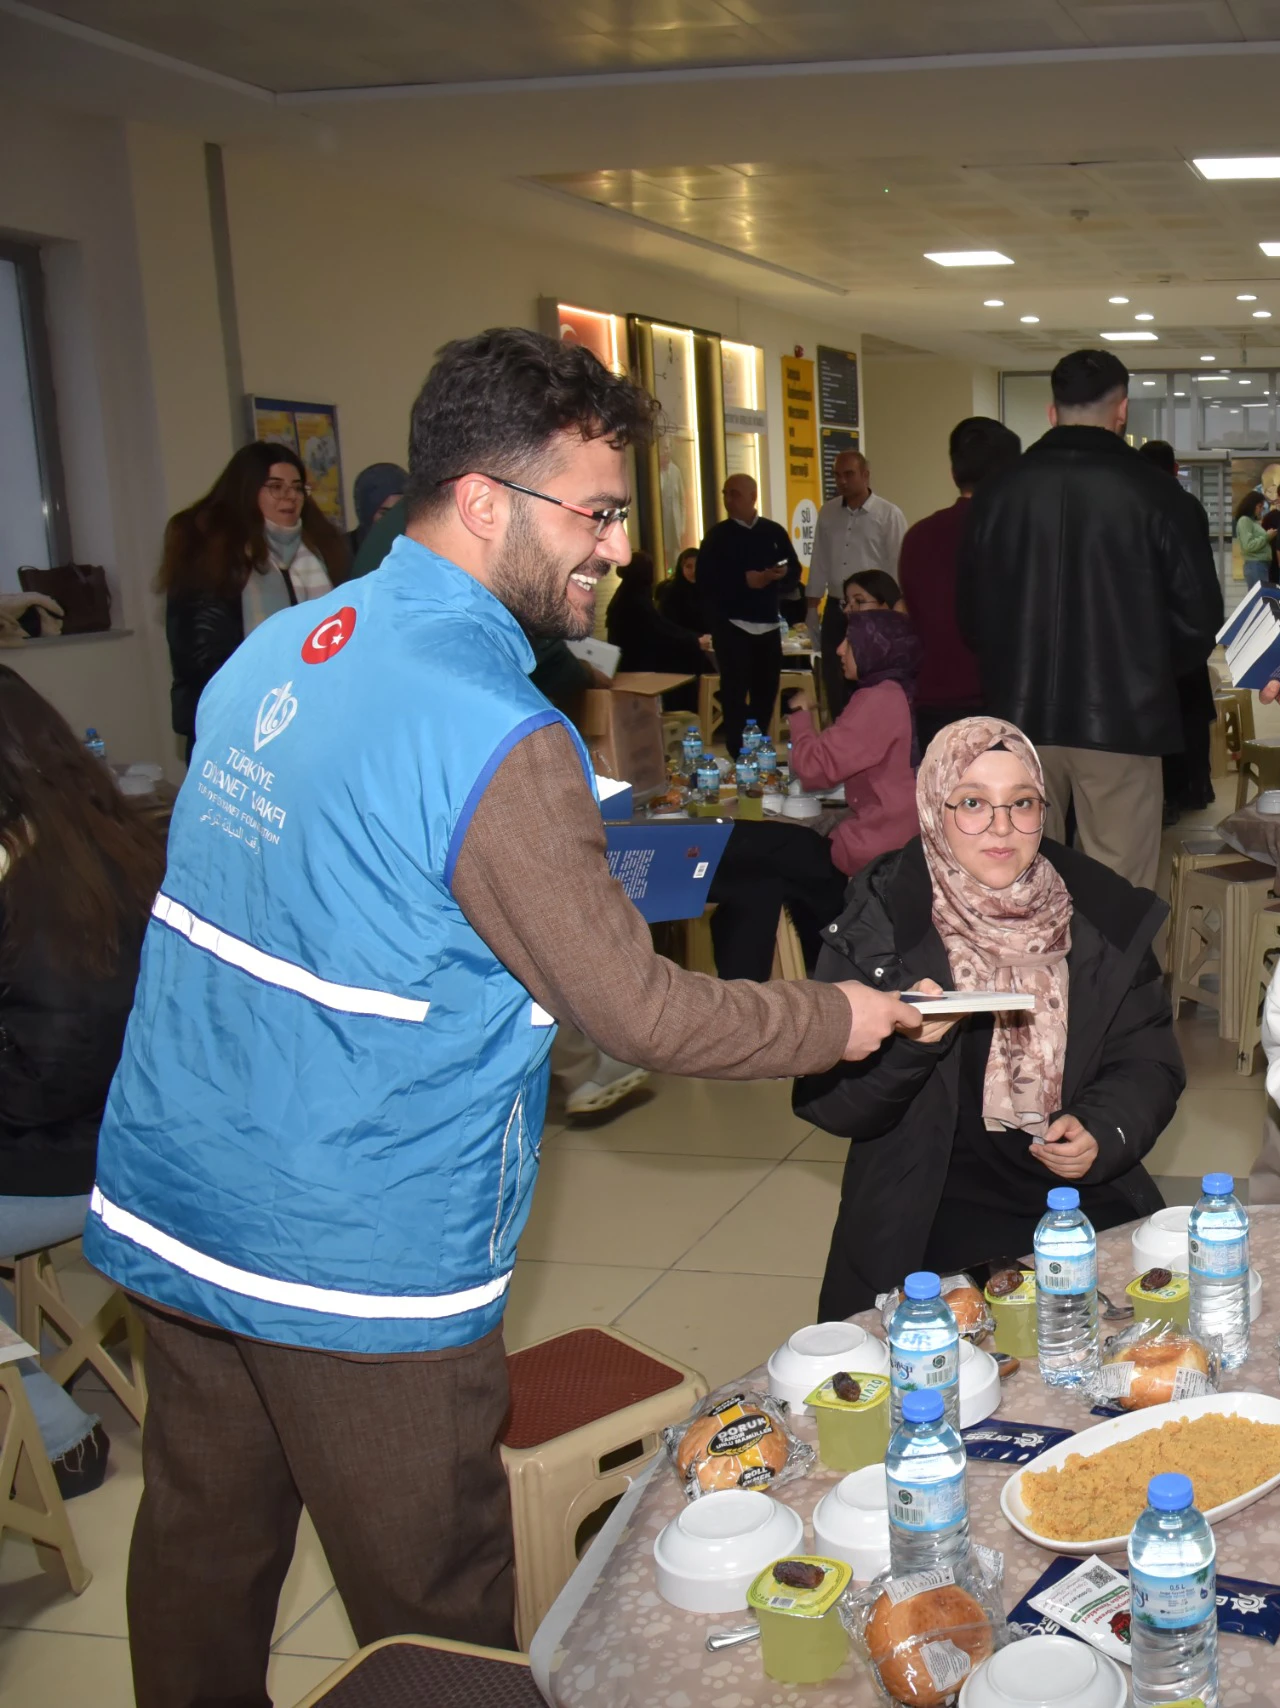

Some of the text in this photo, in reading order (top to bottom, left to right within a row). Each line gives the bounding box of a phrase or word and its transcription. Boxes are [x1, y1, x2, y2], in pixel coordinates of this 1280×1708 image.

[803, 542, 813, 555] DE
[202, 759, 249, 802] DİYANET
[225, 746, 276, 792] TÜRKİYE
[251, 790, 287, 829] VAKFI
[718, 1417, 767, 1439] DORUK
